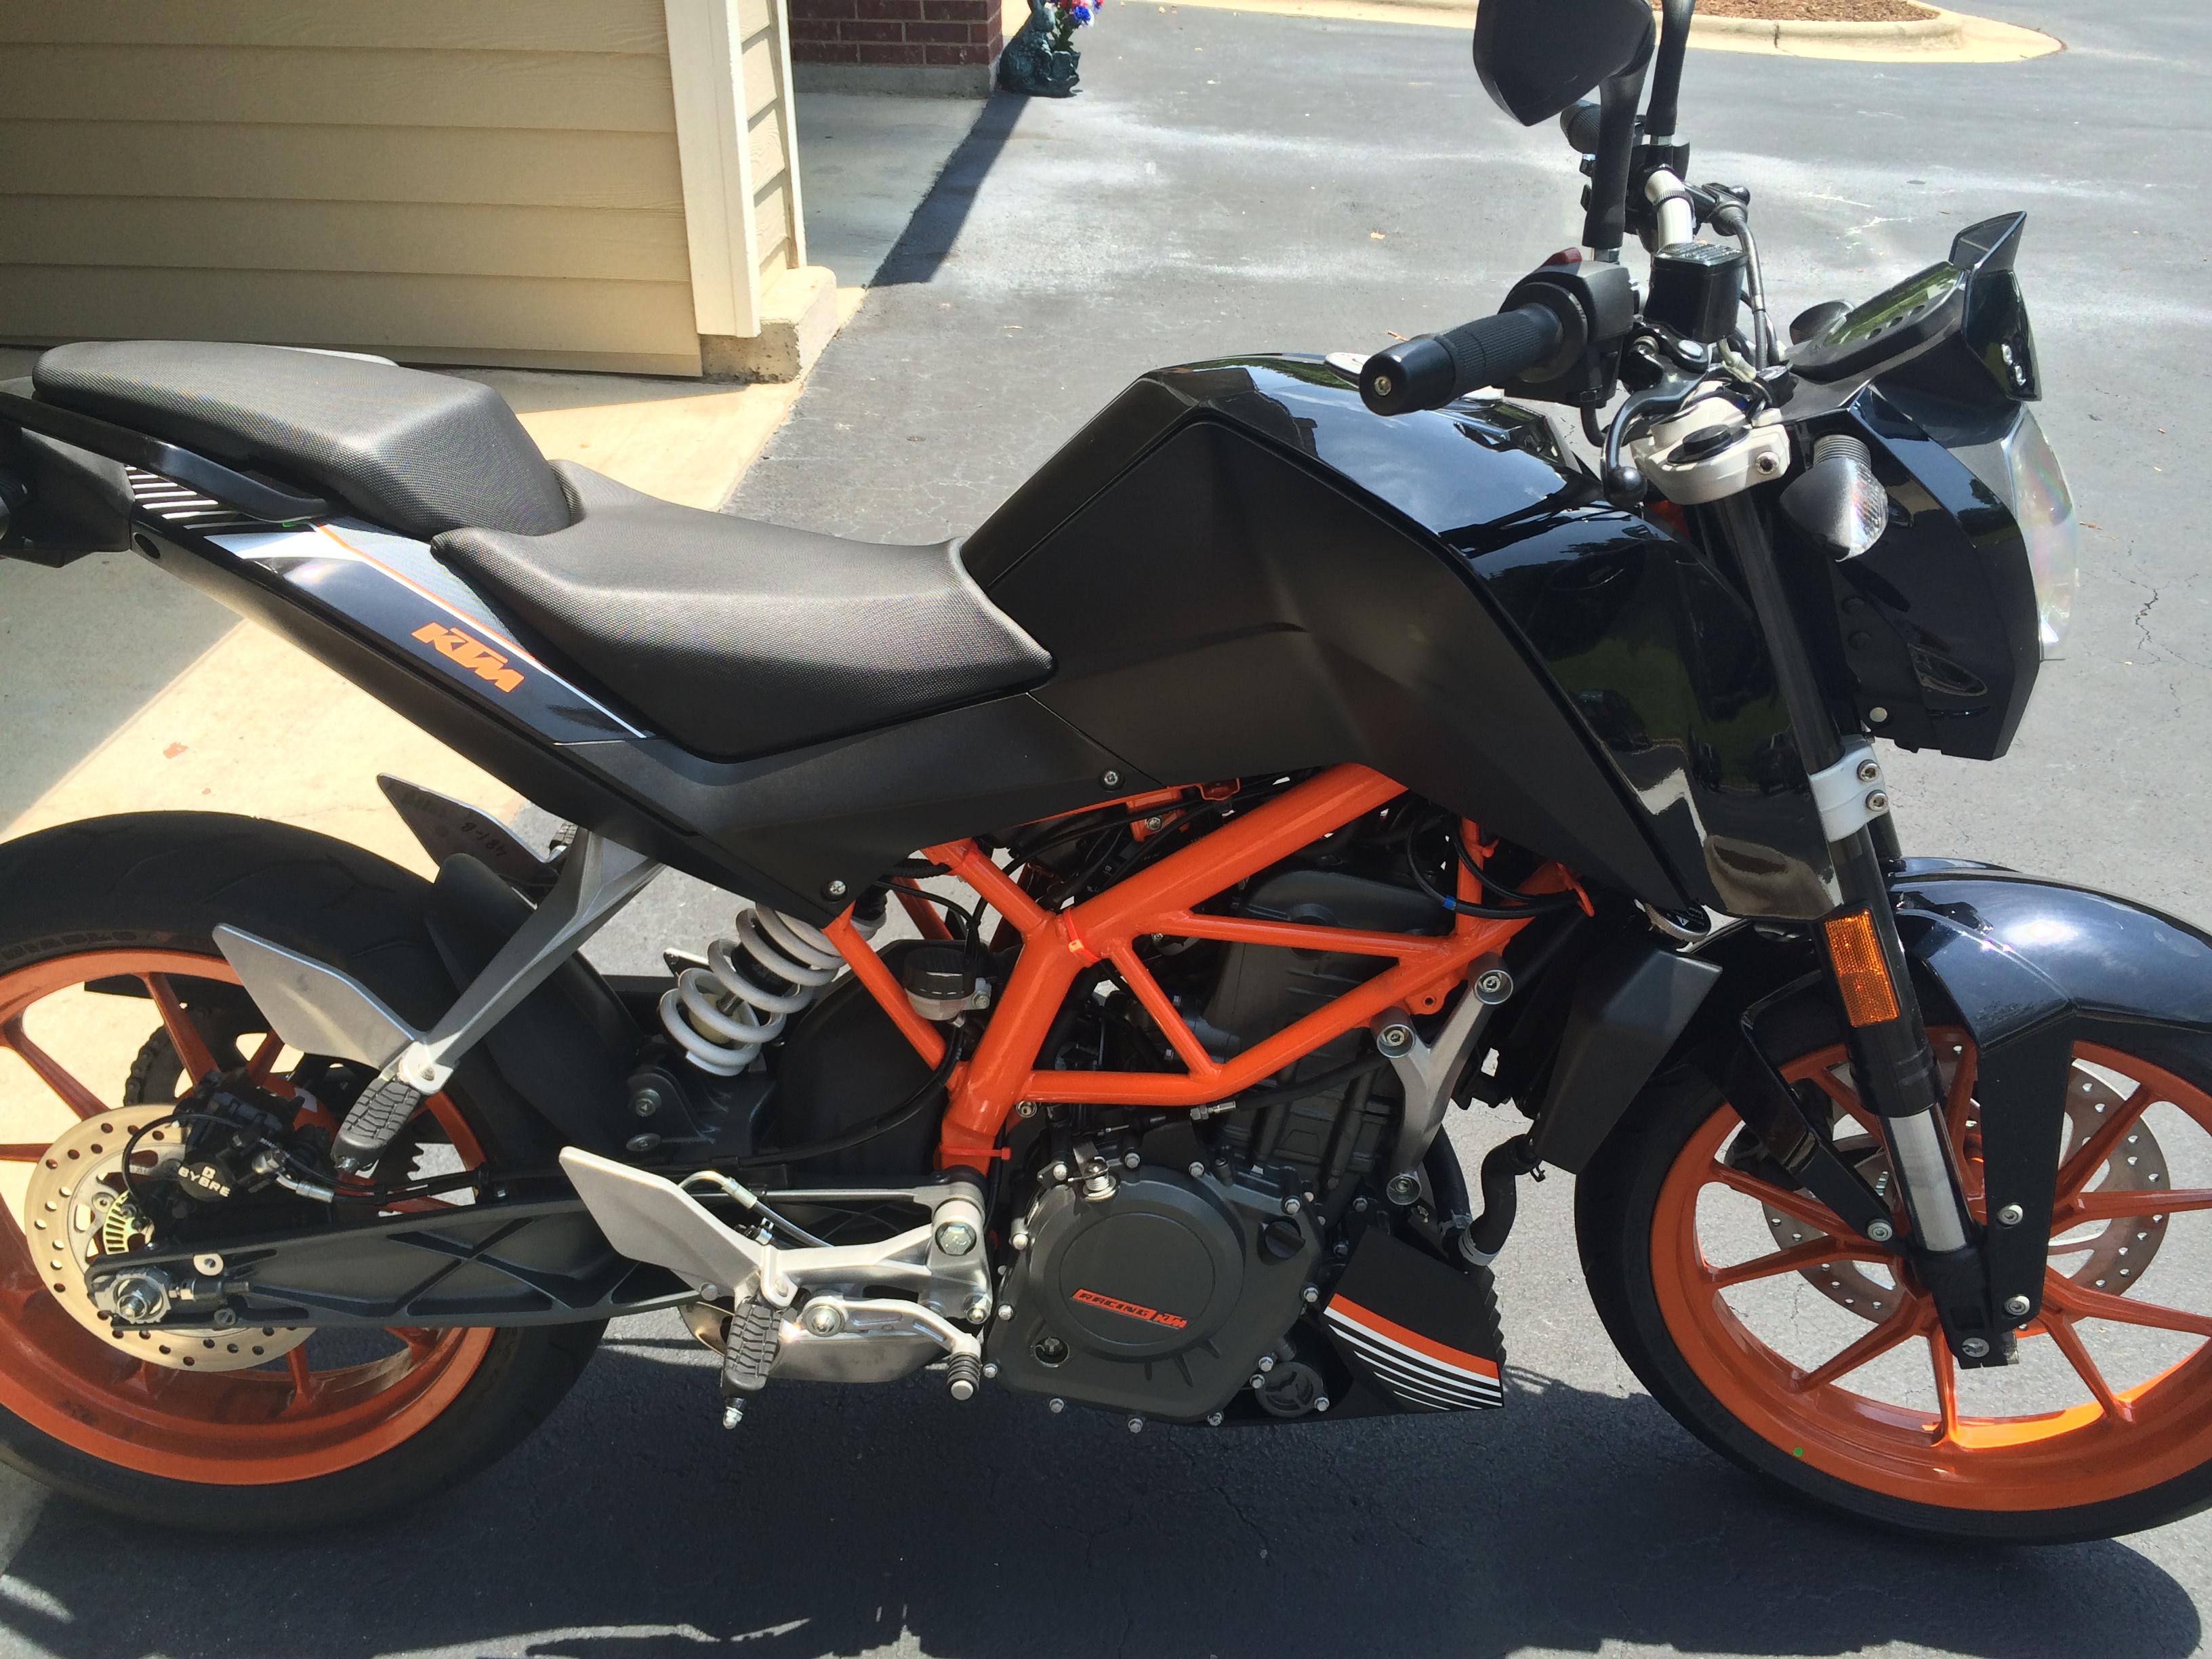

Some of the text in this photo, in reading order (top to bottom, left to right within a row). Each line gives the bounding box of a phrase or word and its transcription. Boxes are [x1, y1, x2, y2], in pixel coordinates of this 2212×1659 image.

[411, 621, 525, 693] KTM
[178, 1166, 230, 1197] BYBRE
[1078, 1291, 1187, 1328] RACING KTM
